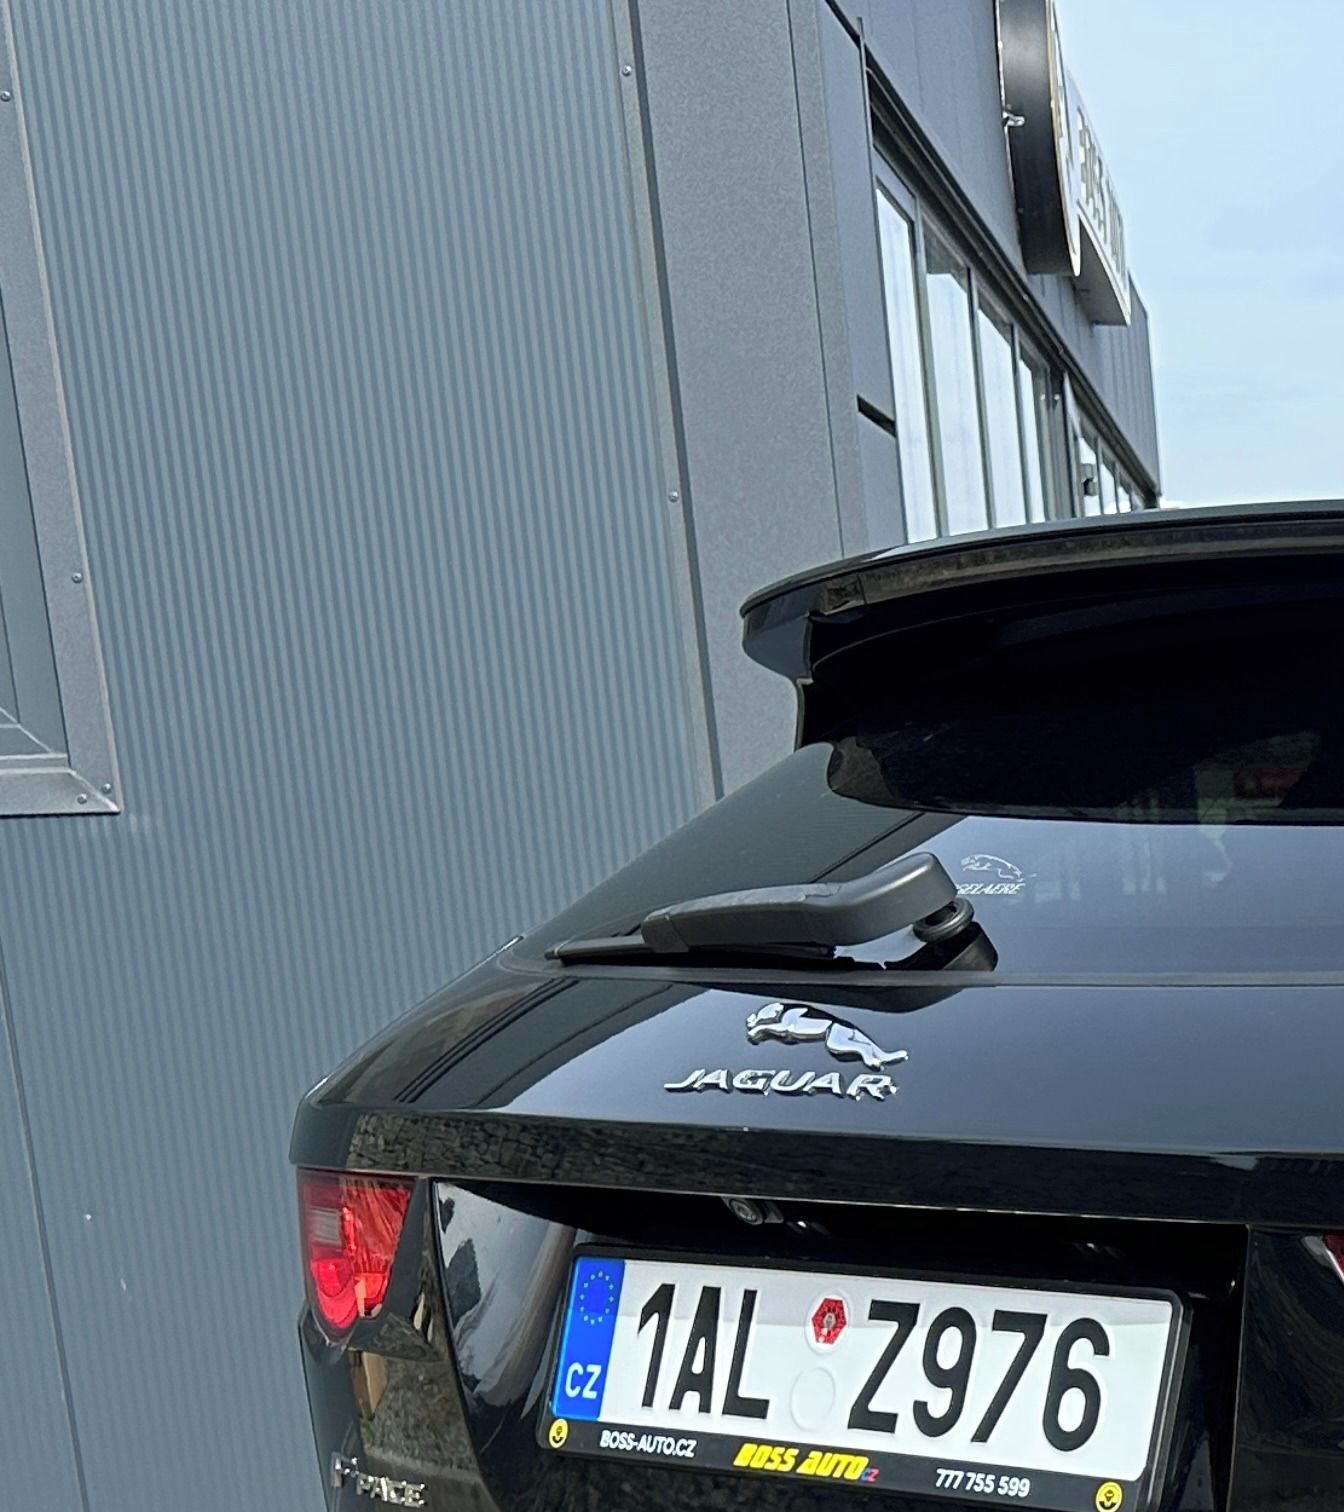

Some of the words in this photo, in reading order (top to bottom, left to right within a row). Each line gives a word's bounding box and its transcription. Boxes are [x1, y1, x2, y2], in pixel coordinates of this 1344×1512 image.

[664, 1068, 897, 1101] JAGUAR
[564, 1362, 602, 1399] CZ
[637, 1282, 771, 1420] 1AL
[847, 1298, 1111, 1452] Z976
[599, 1429, 698, 1458] BOSS-AUTO.CZ
[732, 1443, 799, 1472] BOSS
[935, 1468, 964, 1490] 777
[964, 1472, 996, 1494] 755
[997, 1475, 1031, 1498] 599
